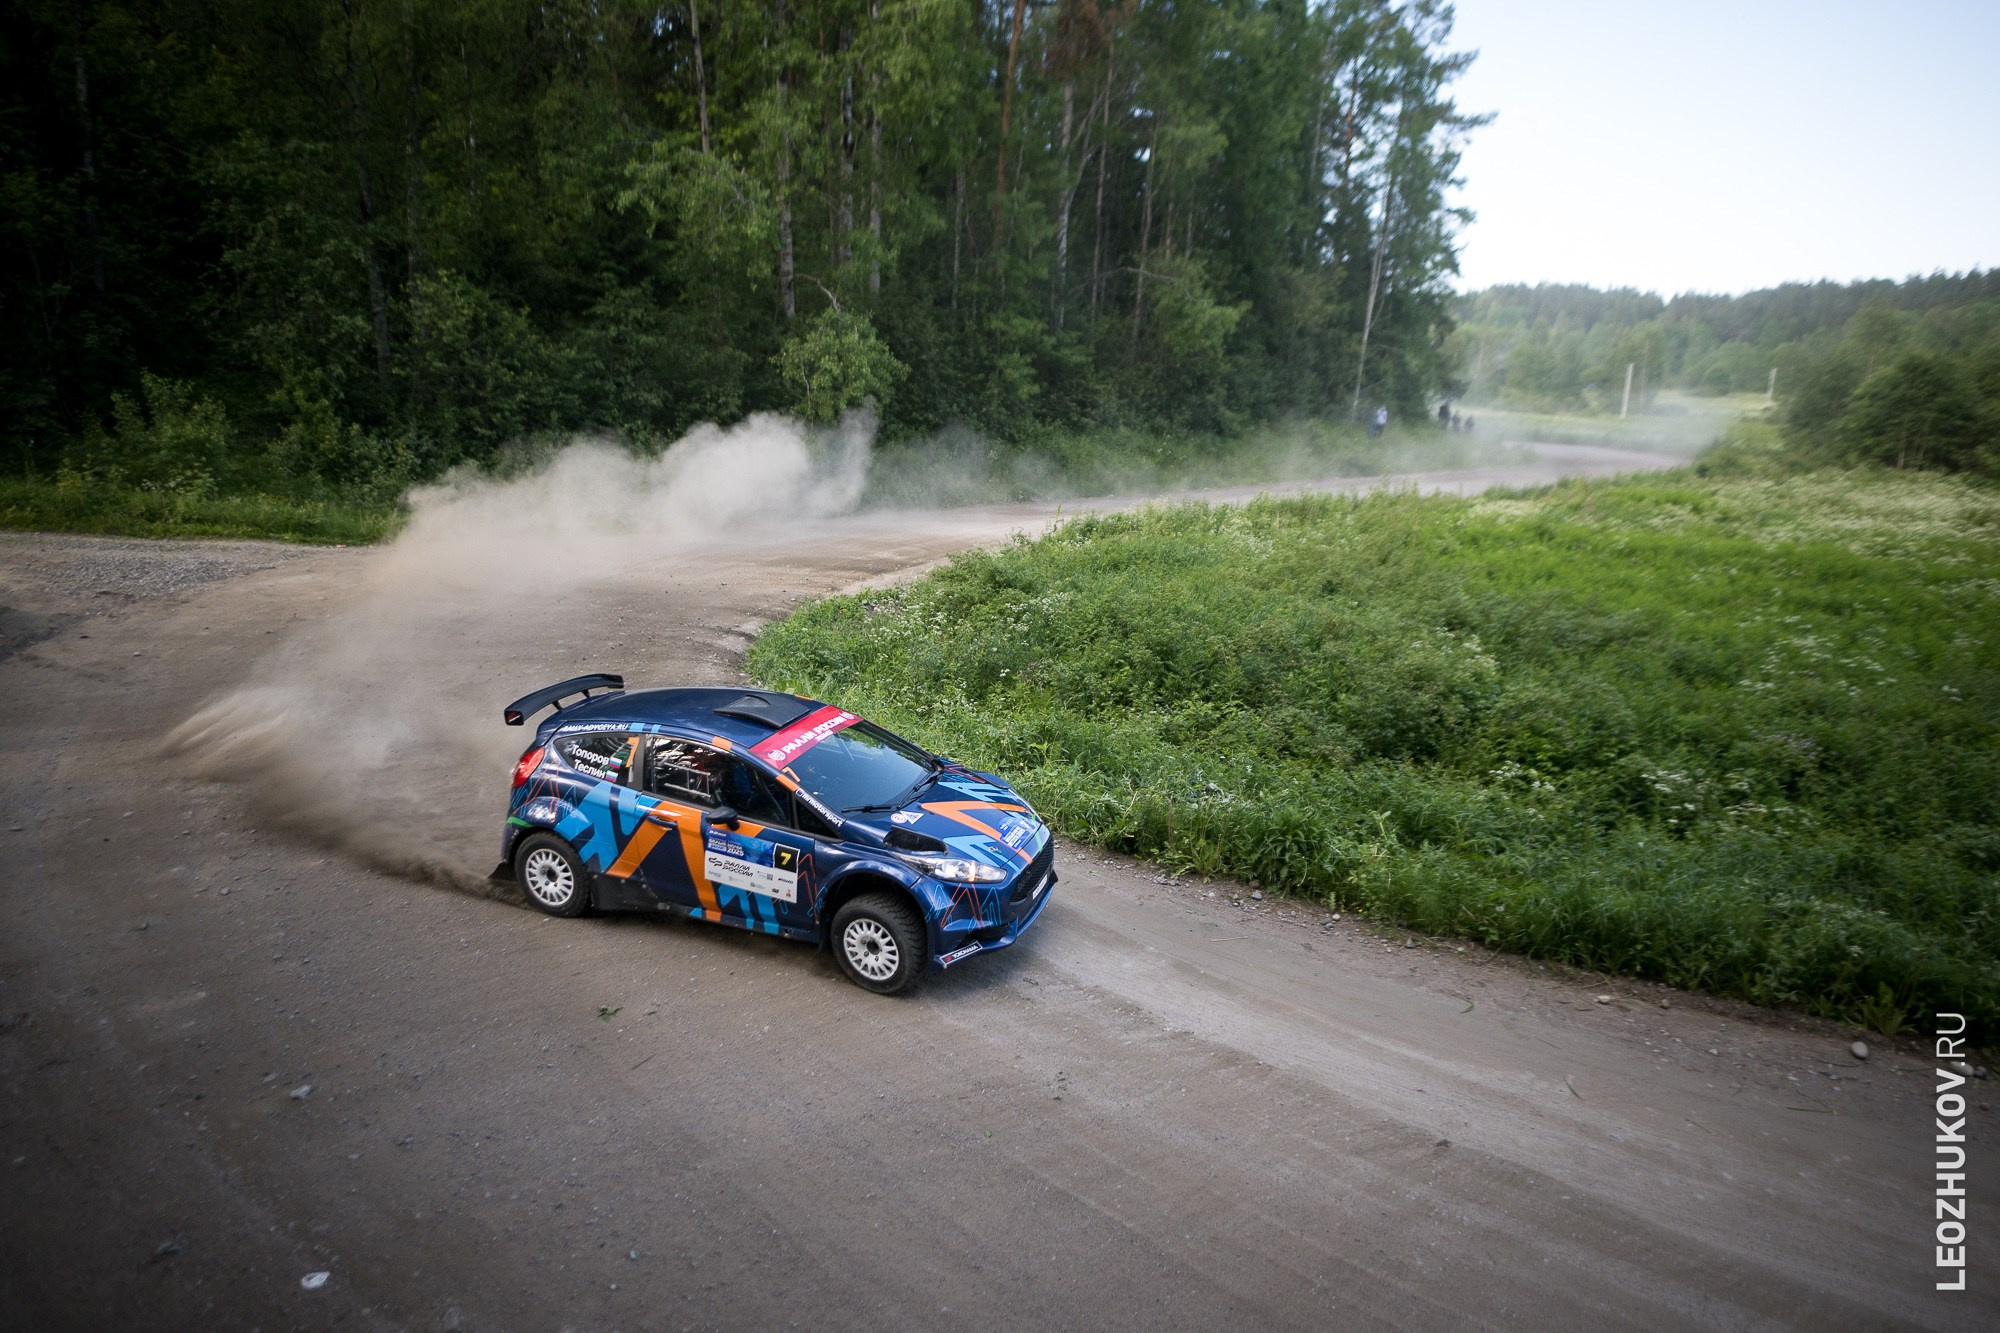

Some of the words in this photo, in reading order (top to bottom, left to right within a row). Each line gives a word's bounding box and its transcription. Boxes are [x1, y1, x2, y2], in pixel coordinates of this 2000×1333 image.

[781, 730, 817, 754] РАЛЛИ
[572, 743, 610, 765] Топоров
[574, 758, 606, 779] Теслин
[780, 851, 792, 866] 7
[952, 945, 979, 959] YOKOHAMA
